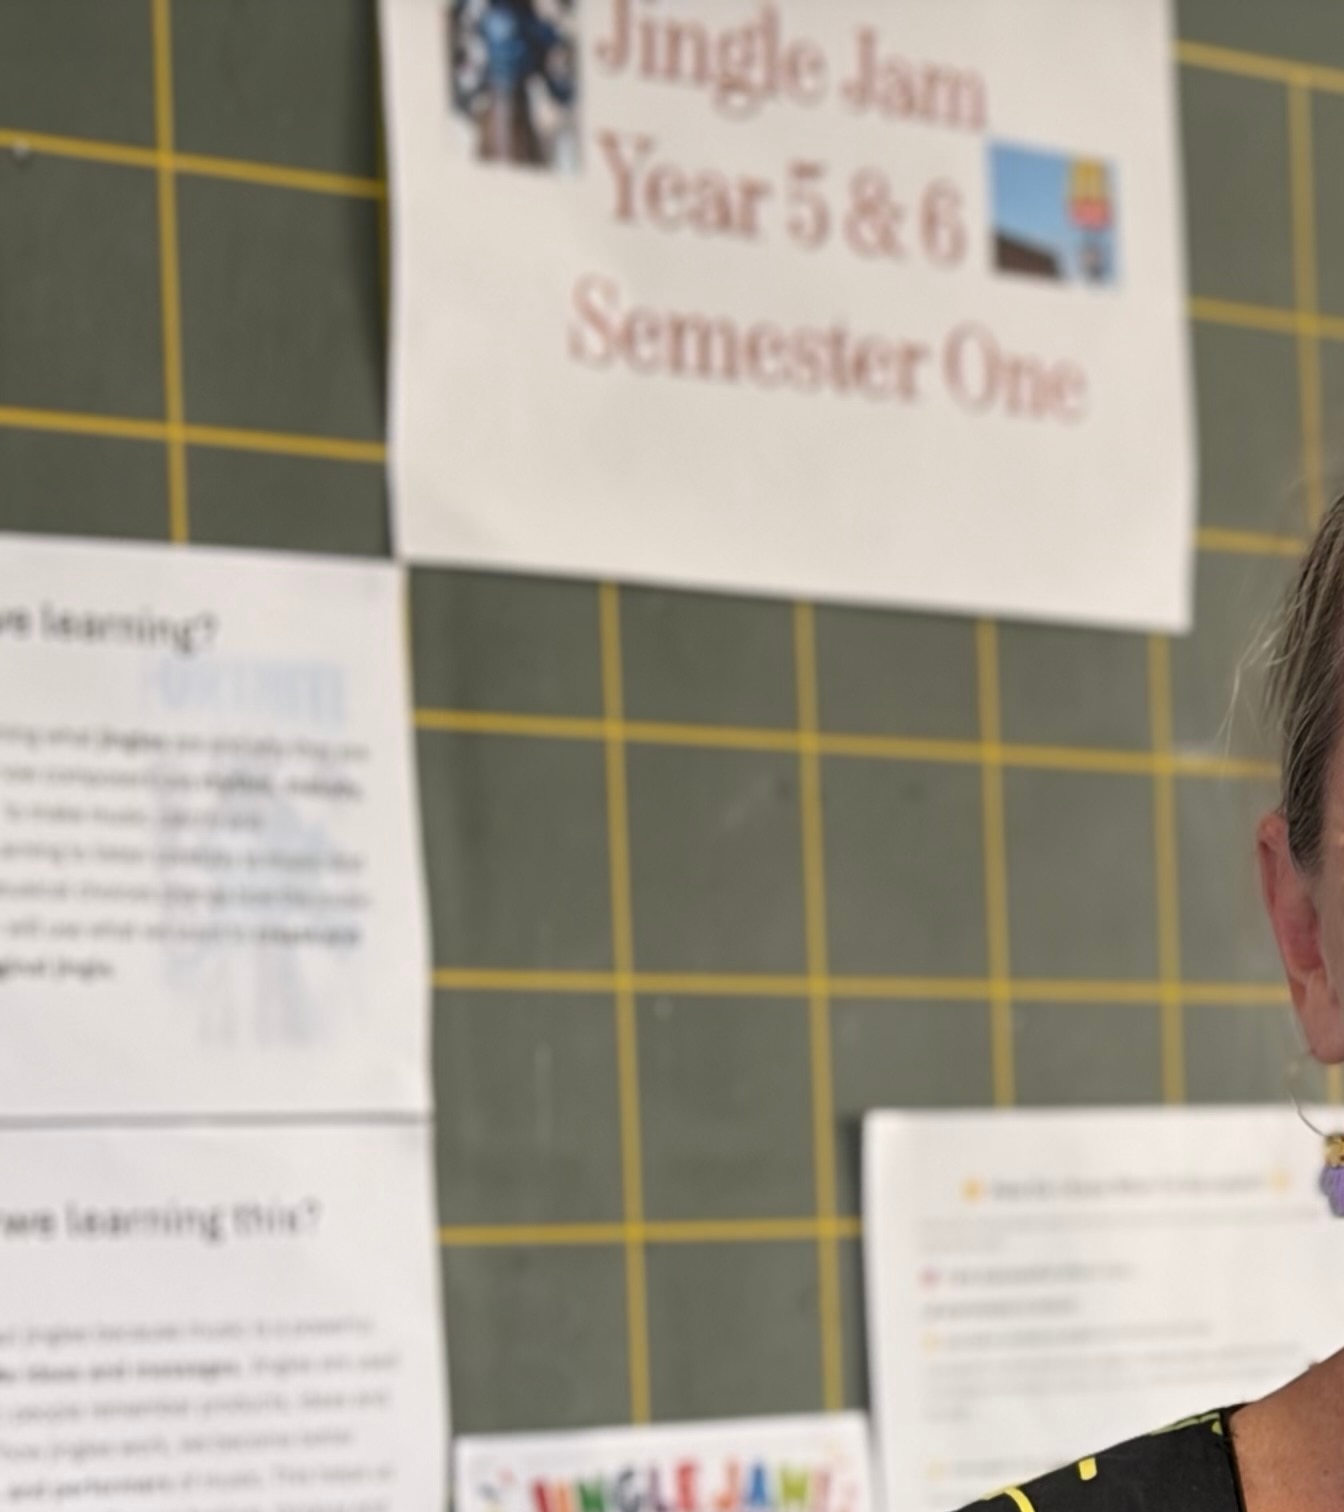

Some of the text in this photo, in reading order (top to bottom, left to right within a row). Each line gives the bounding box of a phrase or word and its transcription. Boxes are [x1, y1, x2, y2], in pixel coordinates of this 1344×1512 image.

[595, 0, 989, 132] Jingle Jam
[597, 128, 967, 268] Year 5 & 6
[568, 274, 1090, 426] Semester One
[39, 600, 219, 653] learning?
[64, 1198, 226, 1248] learning
[231, 1197, 320, 1239] this?
